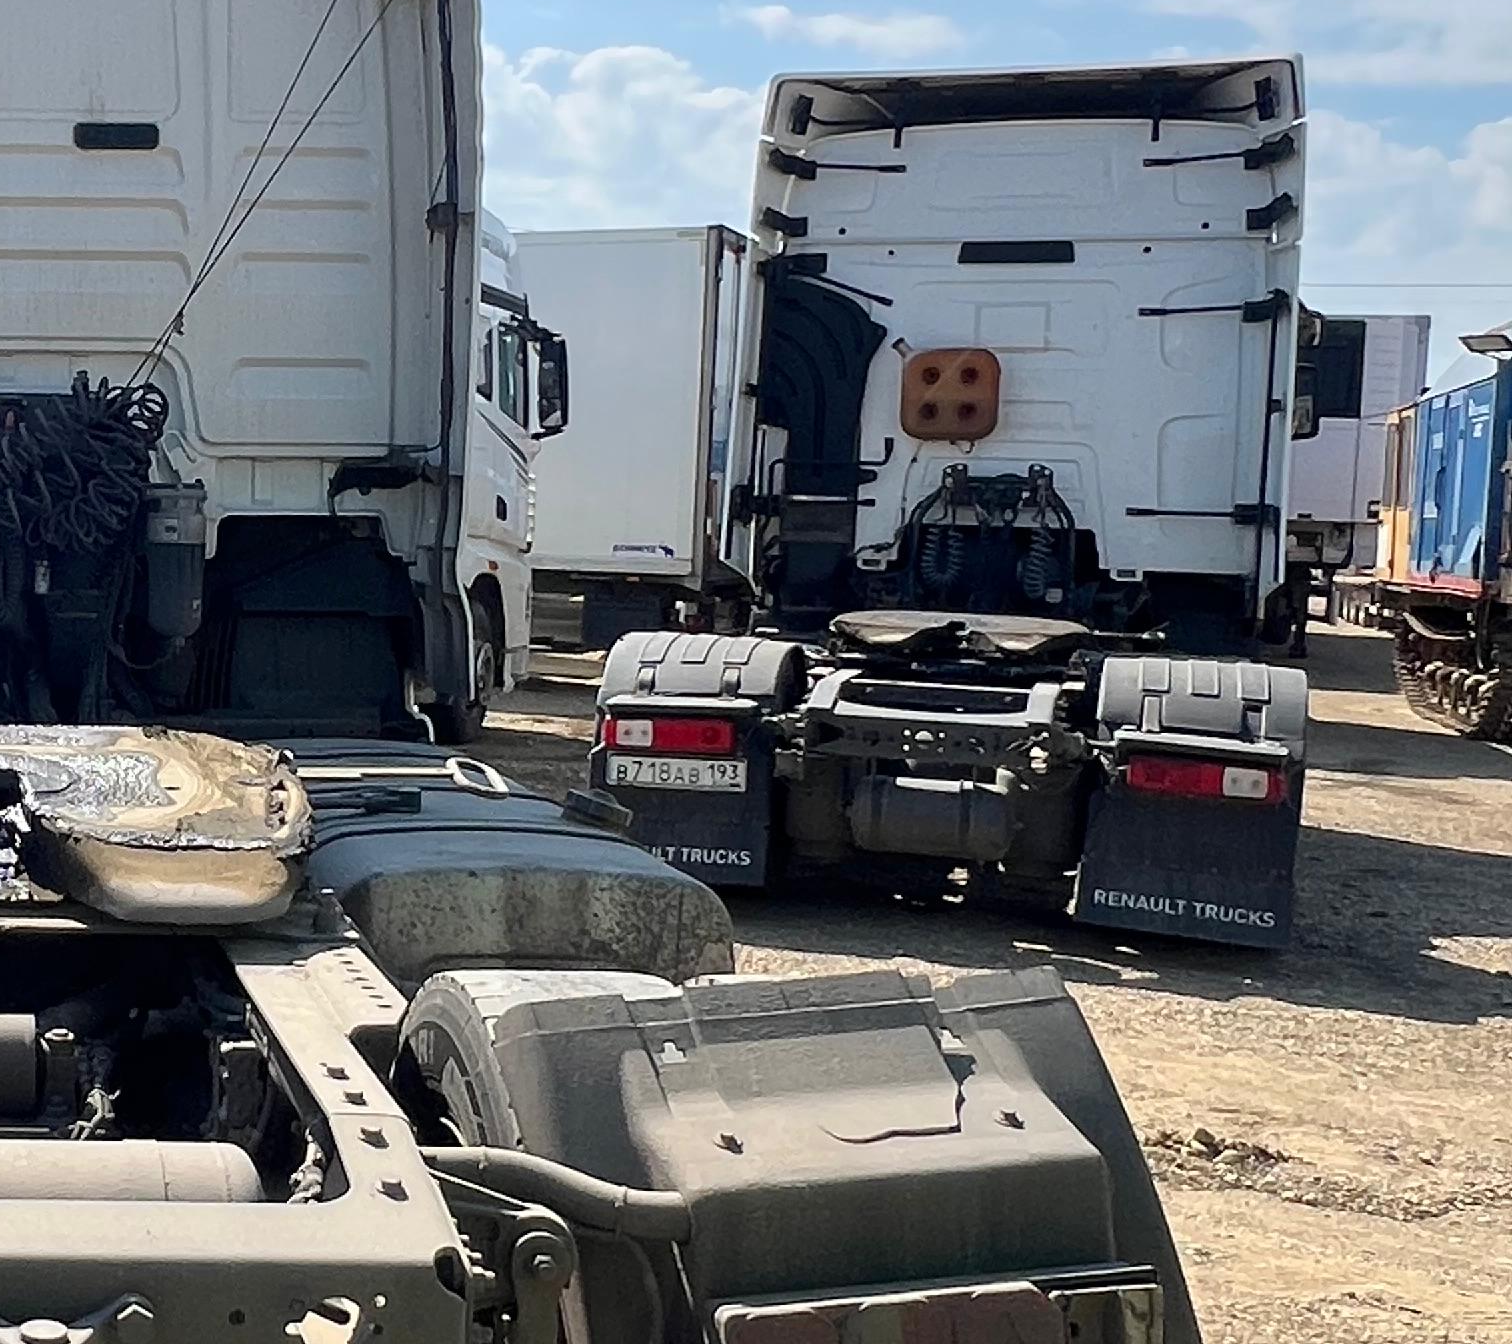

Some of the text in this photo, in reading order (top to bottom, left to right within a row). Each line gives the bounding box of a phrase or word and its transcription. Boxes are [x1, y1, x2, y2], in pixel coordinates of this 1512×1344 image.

[707, 764, 738, 780] 193
[681, 847, 752, 866] TRUCKS
[1094, 889, 1276, 927] RENAULT TRUCKS
